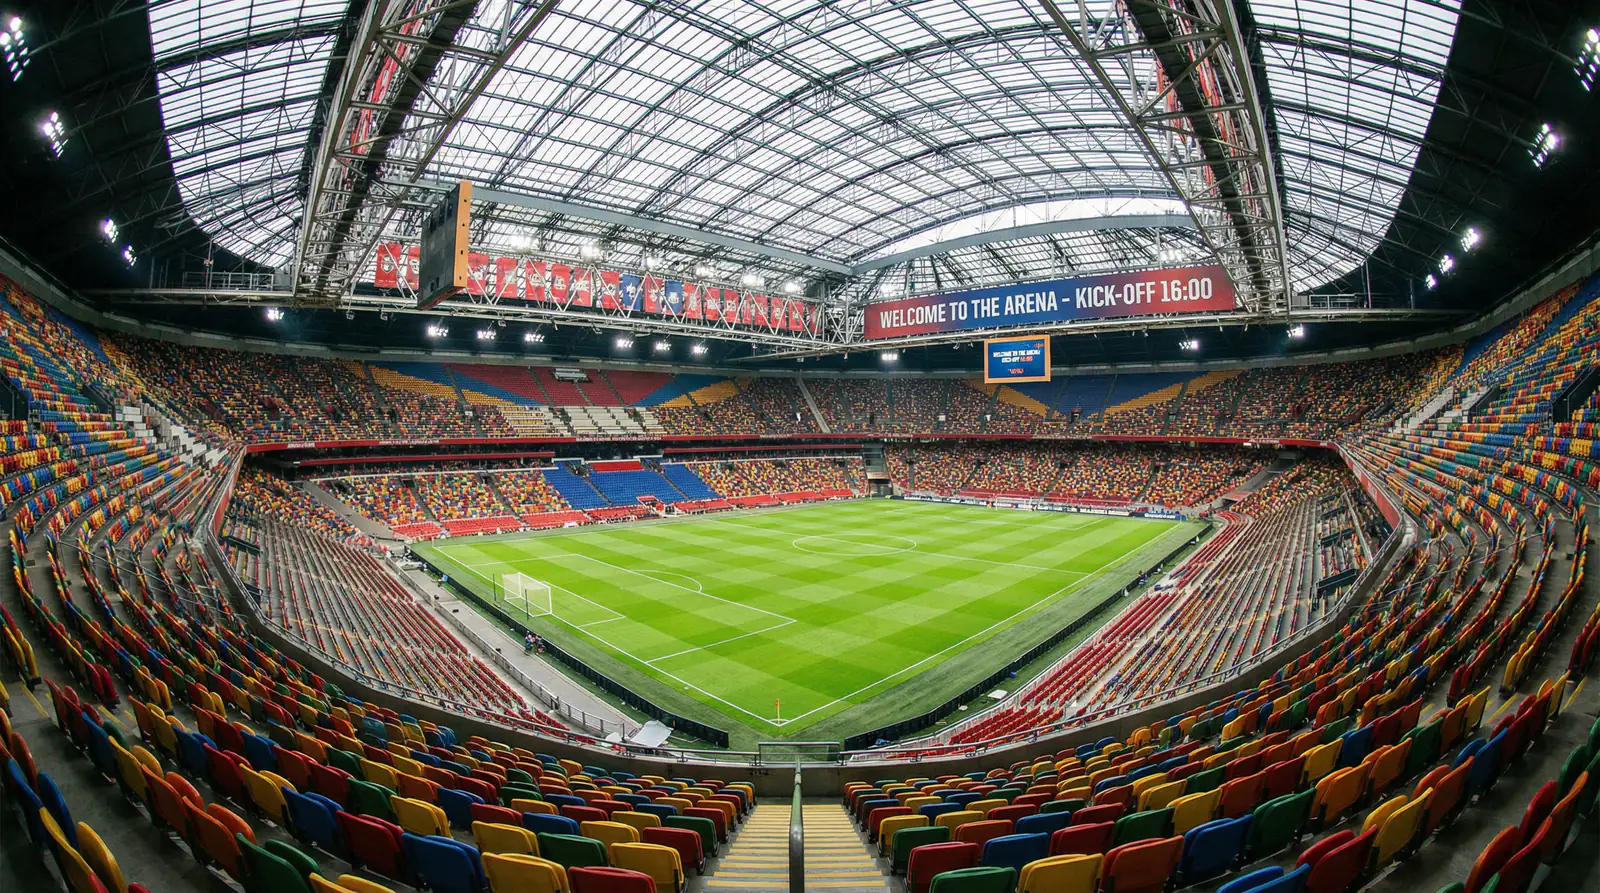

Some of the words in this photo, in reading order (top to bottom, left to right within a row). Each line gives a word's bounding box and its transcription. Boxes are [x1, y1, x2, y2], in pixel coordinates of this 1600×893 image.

[880, 304, 946, 329] WELCOME
[949, 301, 967, 321] TO
[971, 297, 1000, 319] THE
[1004, 291, 1058, 316] ARENA
[1075, 281, 1156, 309] KICK-OFF
[1160, 277, 1213, 303] 16:00
